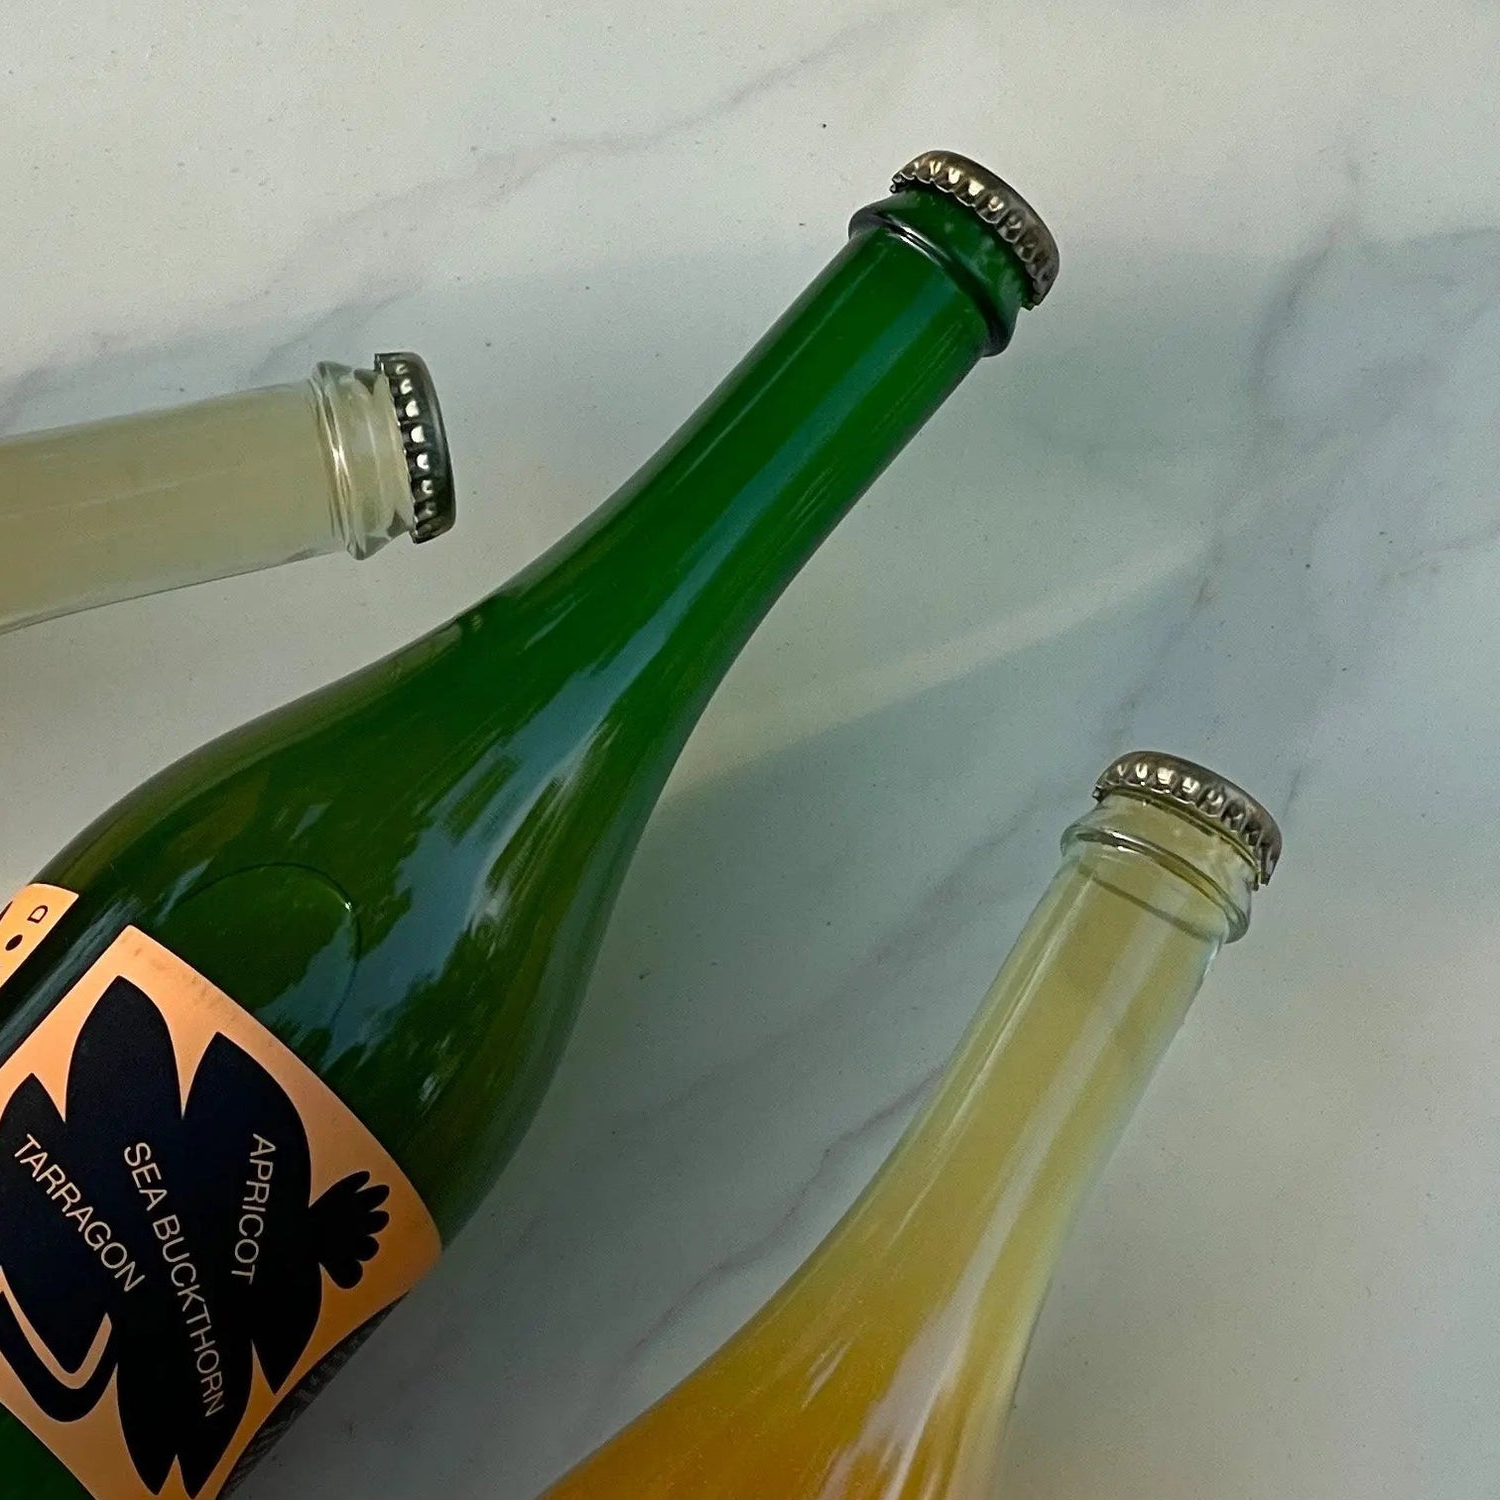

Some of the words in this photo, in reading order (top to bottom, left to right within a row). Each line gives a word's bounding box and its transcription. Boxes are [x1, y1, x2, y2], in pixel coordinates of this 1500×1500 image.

[27, 905, 48, 923] D
[14, 1133, 146, 1292] TARRAGON
[123, 1142, 161, 1212] SEA
[153, 1214, 223, 1416] BUCKTHORN
[232, 1134, 276, 1283] APRICOT
